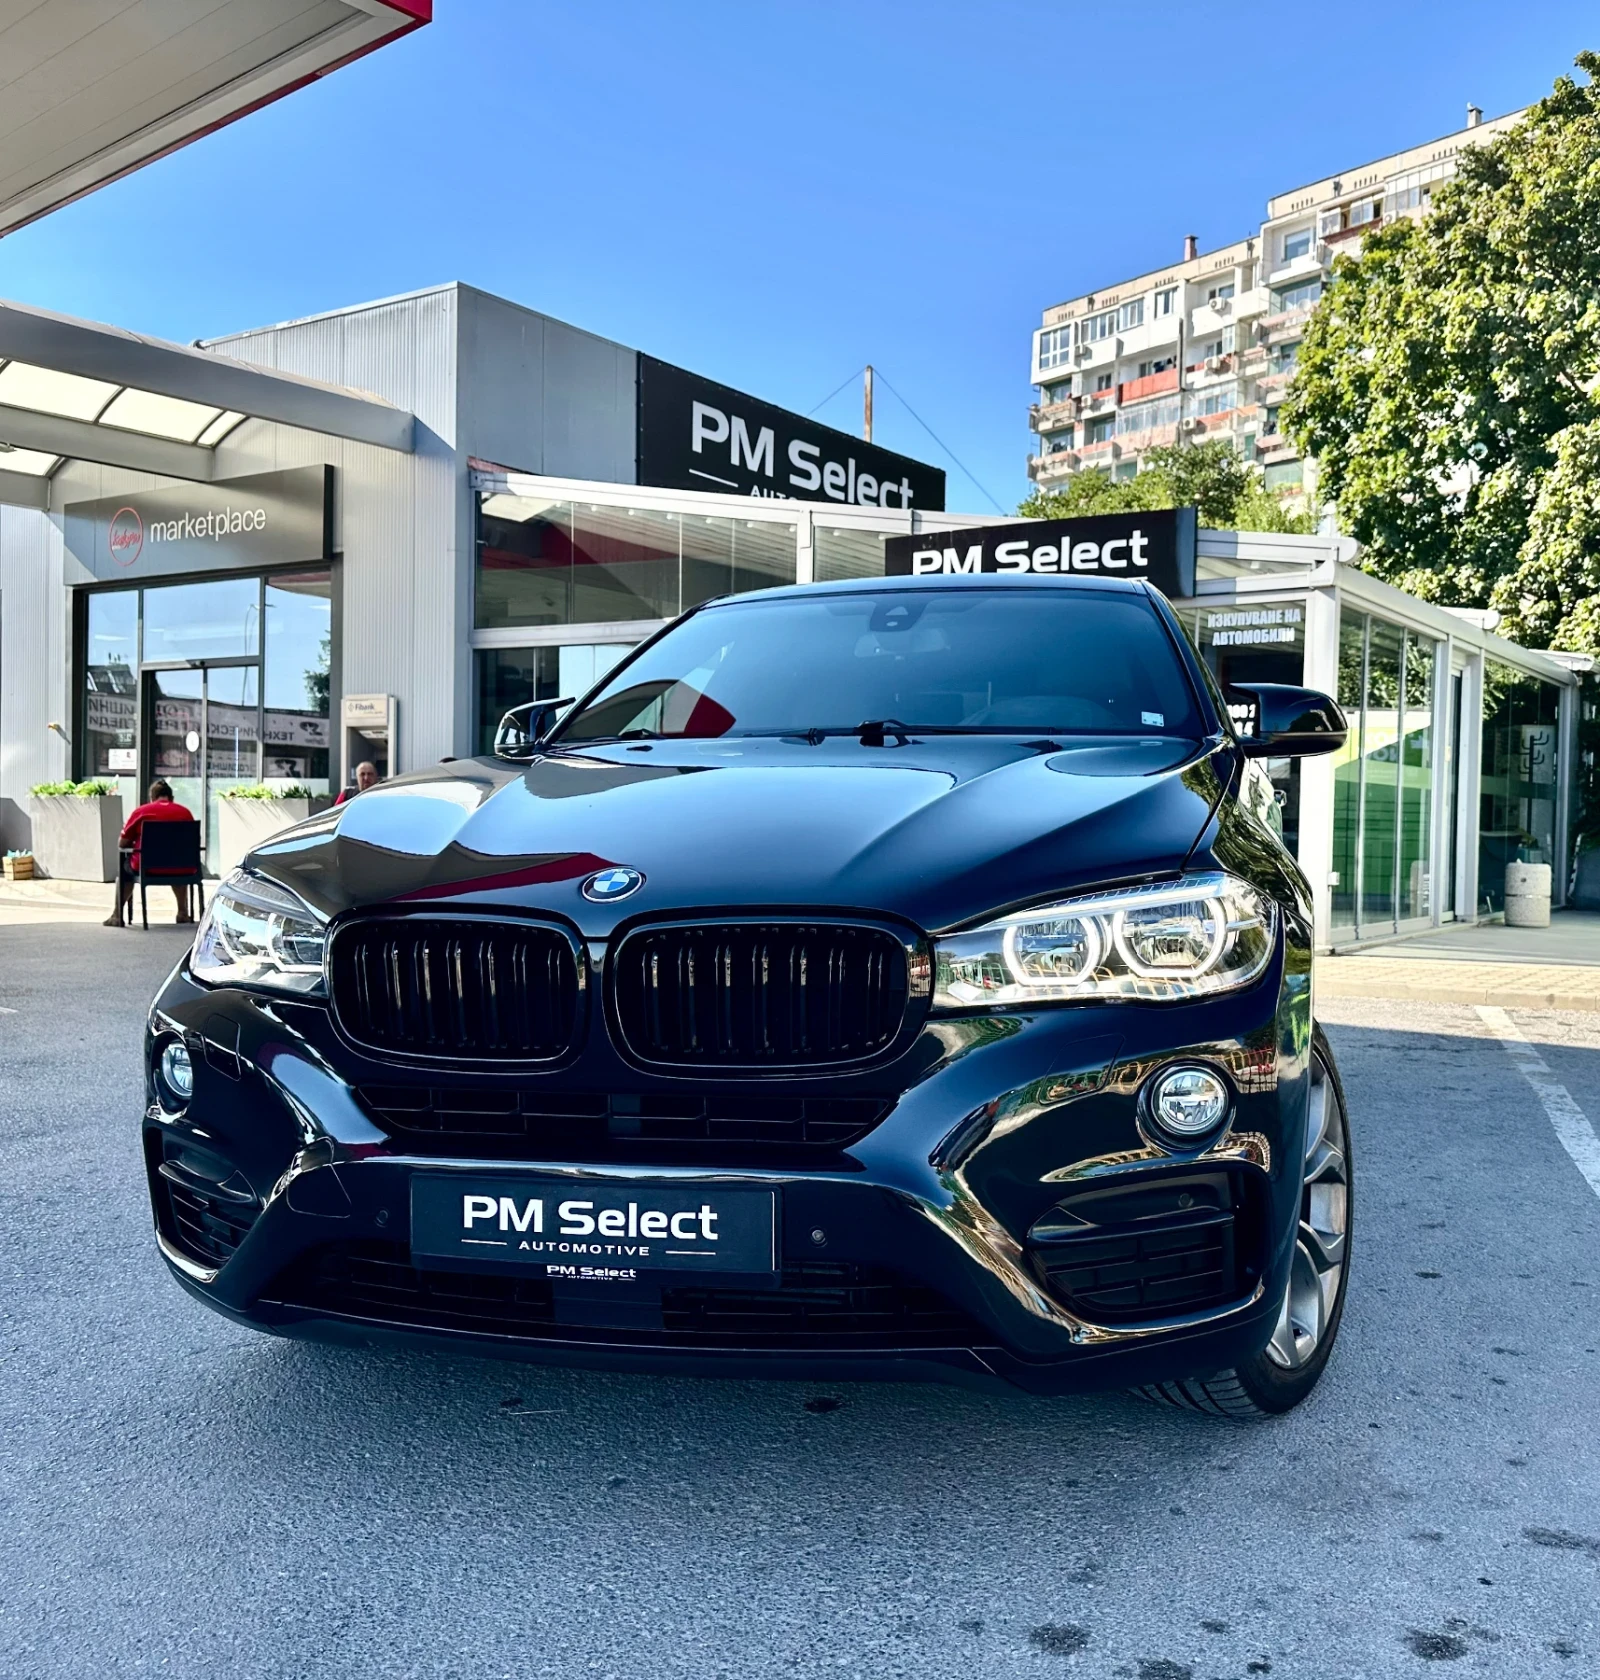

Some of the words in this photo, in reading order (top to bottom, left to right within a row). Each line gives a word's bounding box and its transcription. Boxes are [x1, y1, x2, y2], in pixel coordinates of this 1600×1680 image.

[691, 400, 775, 478] PM
[787, 439, 914, 510] Select
[150, 506, 267, 543] marketplace
[912, 545, 982, 576] PM
[995, 529, 1149, 574] Select
[1207, 609, 1283, 628] ИЗКУПУВАНЕ
[1284, 608, 1301, 623] НА
[1212, 627, 1296, 646] АВТОМОБИЛИ
[463, 1195, 543, 1232] PM
[558, 1200, 719, 1240] Select
[519, 1241, 650, 1256] AUTOMOTIVE
[546, 1265, 576, 1275] PM
[580, 1267, 637, 1278] Select
